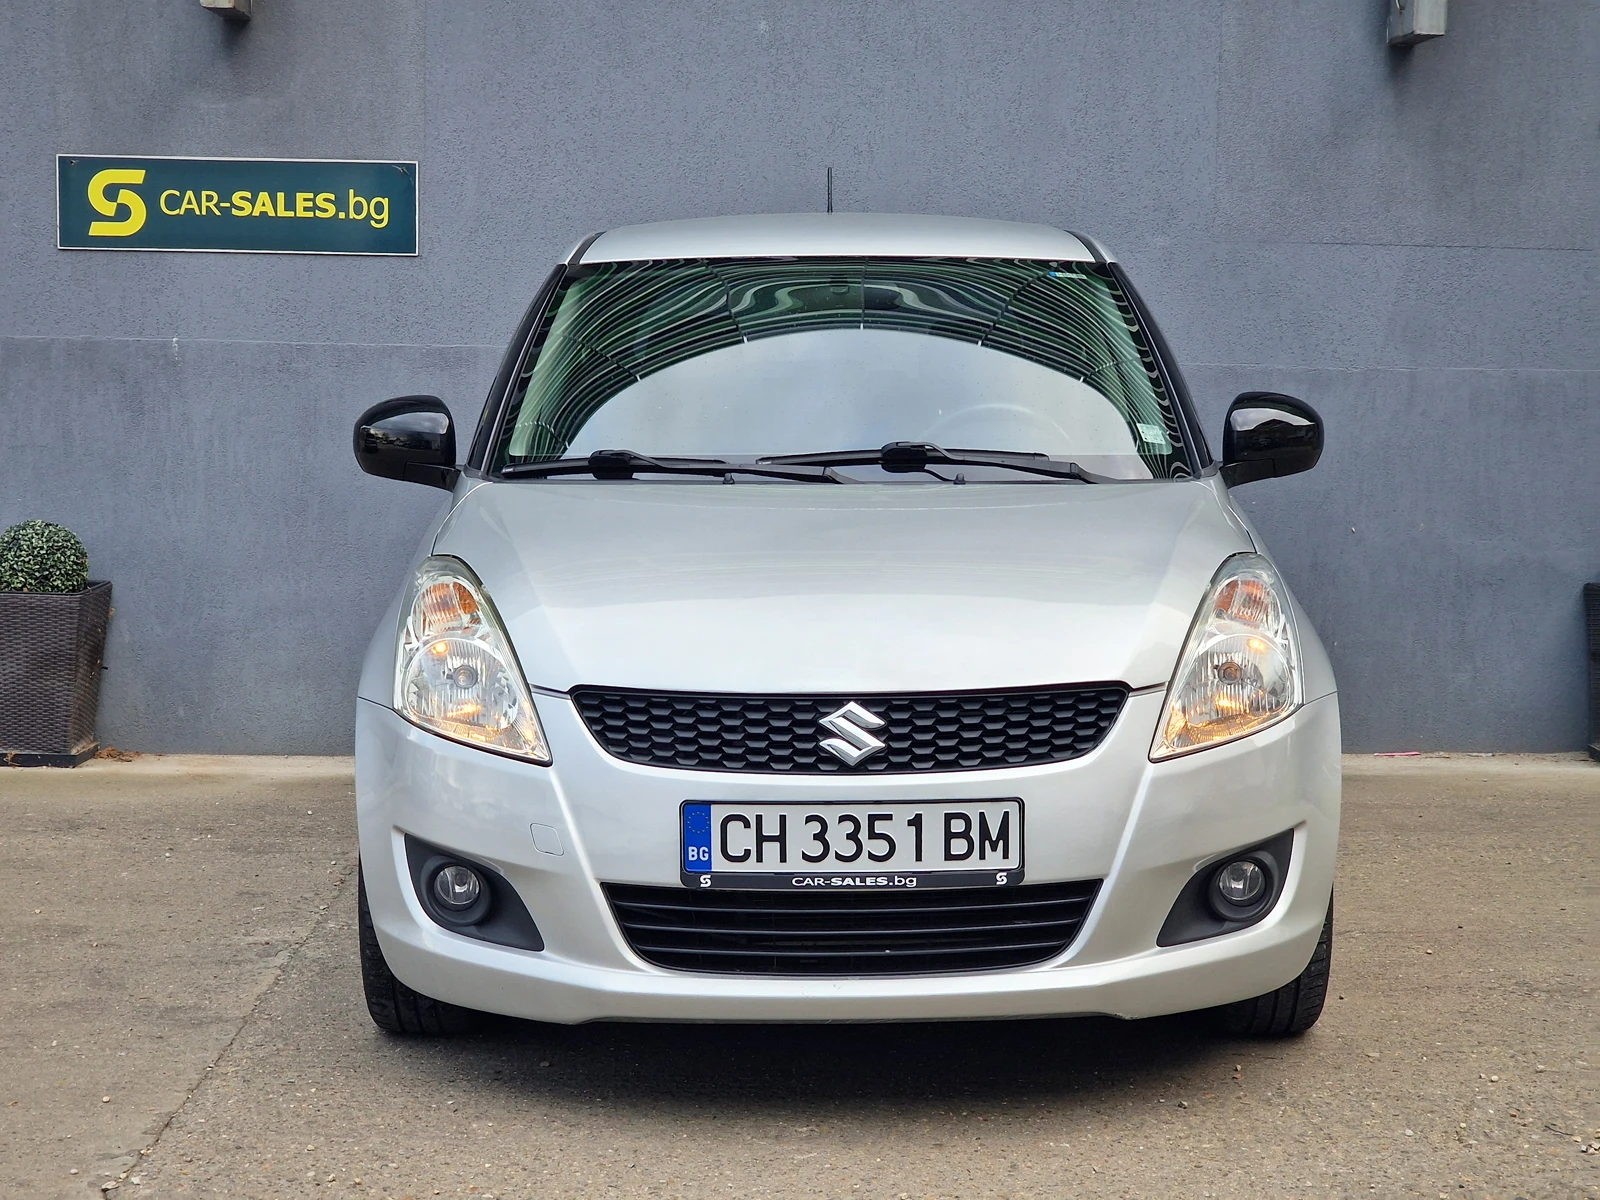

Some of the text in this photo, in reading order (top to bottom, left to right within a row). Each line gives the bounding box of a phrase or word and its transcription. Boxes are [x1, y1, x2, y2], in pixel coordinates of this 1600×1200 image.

[159, 188, 389, 229] CAR-SALES.bg
[719, 810, 1010, 863] CH 3351 BM
[688, 846, 709, 861] BG
[791, 875, 917, 888] CAR-SALES.bg
